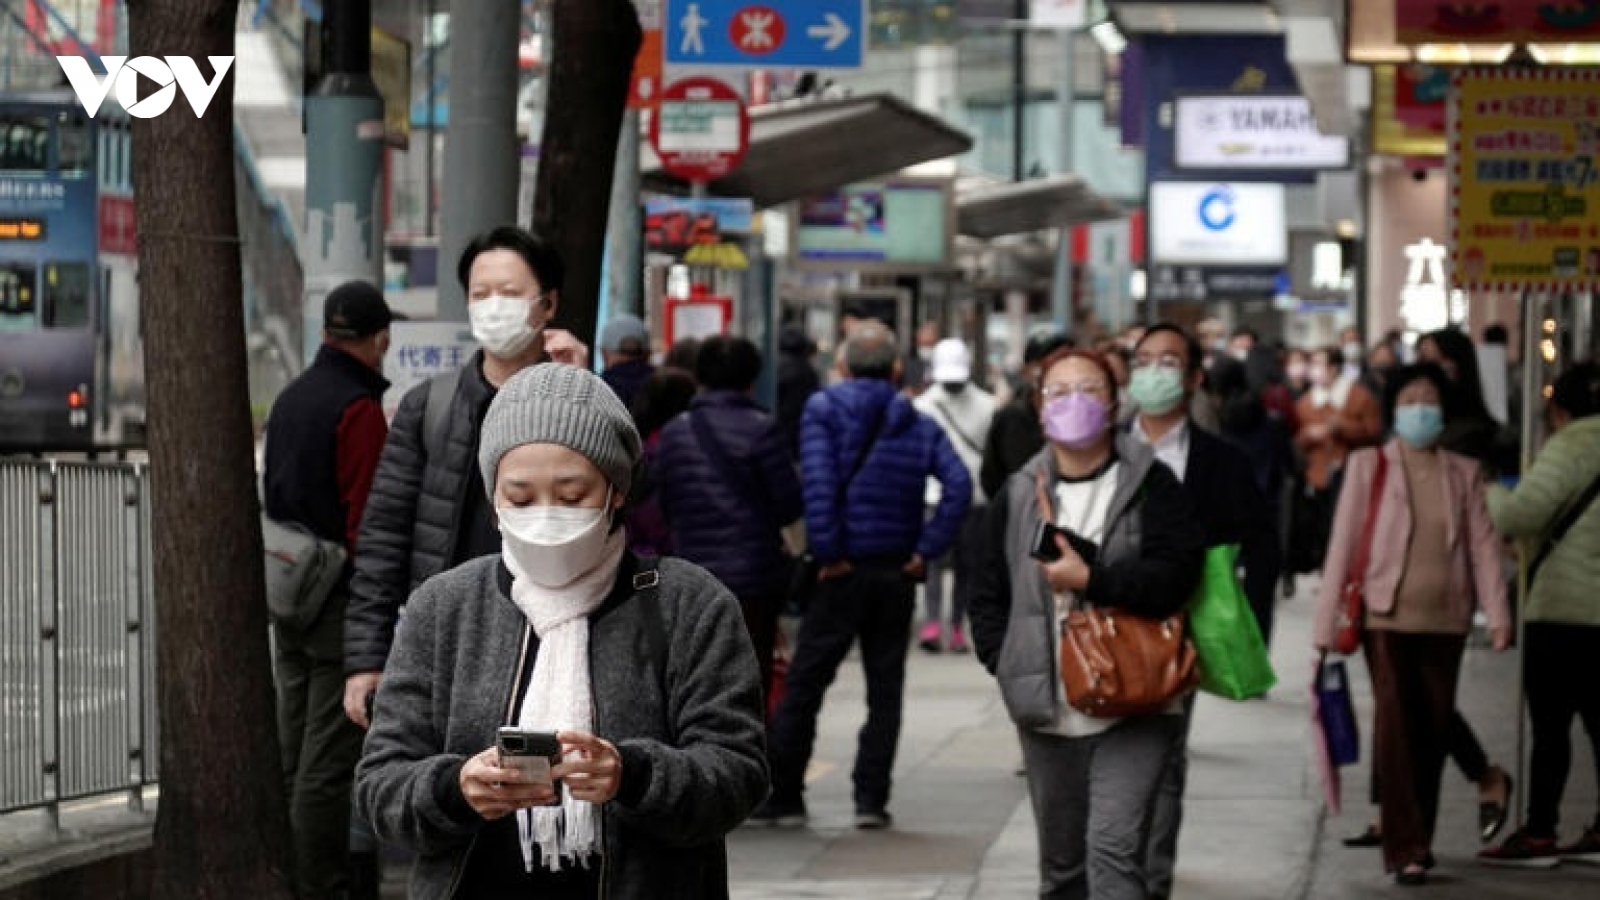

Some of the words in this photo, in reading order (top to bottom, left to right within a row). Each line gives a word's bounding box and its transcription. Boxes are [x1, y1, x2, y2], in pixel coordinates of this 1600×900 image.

[1230, 105, 1317, 132] YAMAH
[397, 345, 465, 368] 代寄王
